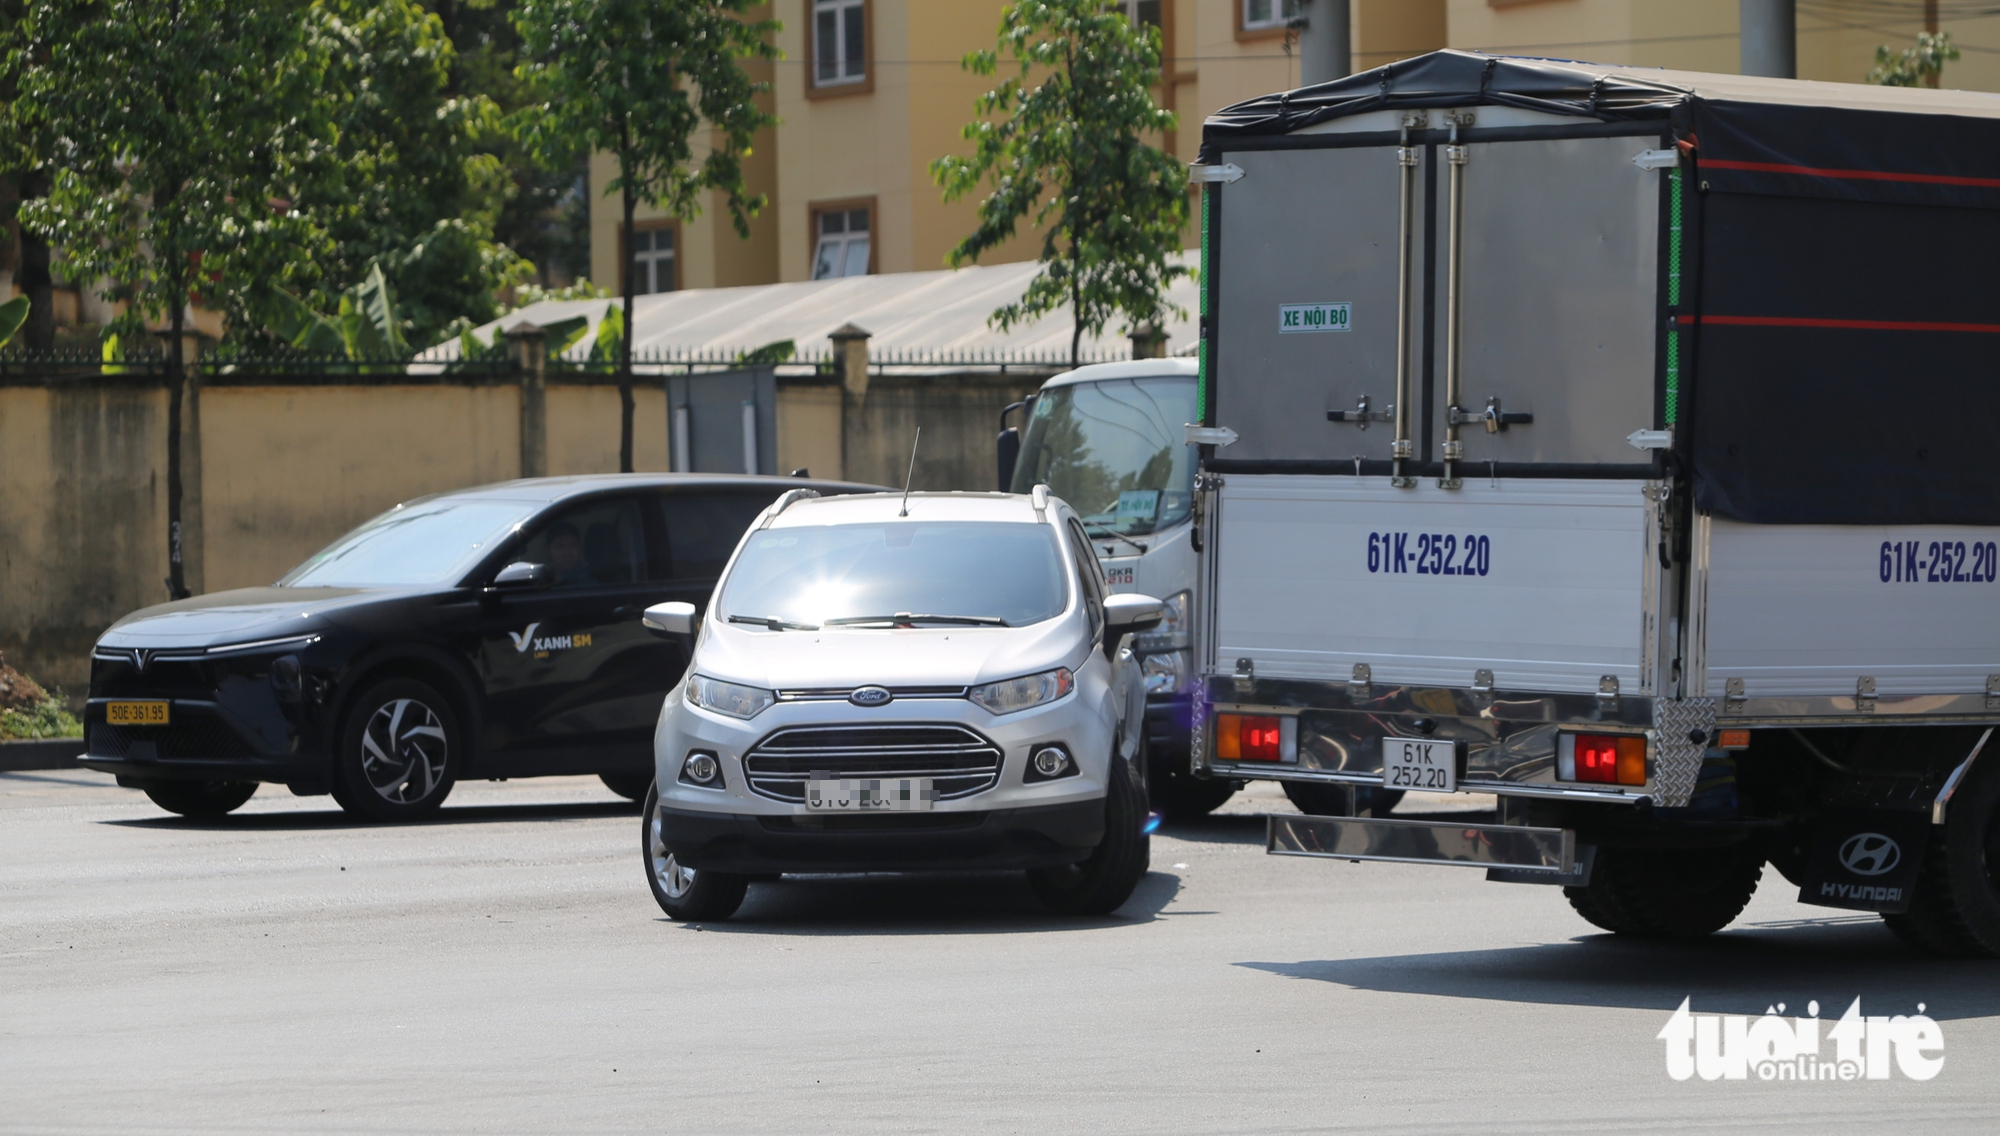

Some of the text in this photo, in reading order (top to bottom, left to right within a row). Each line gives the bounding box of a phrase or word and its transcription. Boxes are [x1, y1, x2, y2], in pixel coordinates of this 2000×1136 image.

[1283, 305, 1347, 328] XE NỘI BỘ
[1367, 531, 1490, 577] 61K-252.20
[1880, 540, 1997, 583] 61K-252.20
[533, 633, 592, 651] XANH SM
[859, 690, 881, 700] Ford
[1404, 743, 1433, 764] 61K
[1392, 765, 1447, 788] 252.20
[1821, 882, 1902, 901] HYUNDAI
